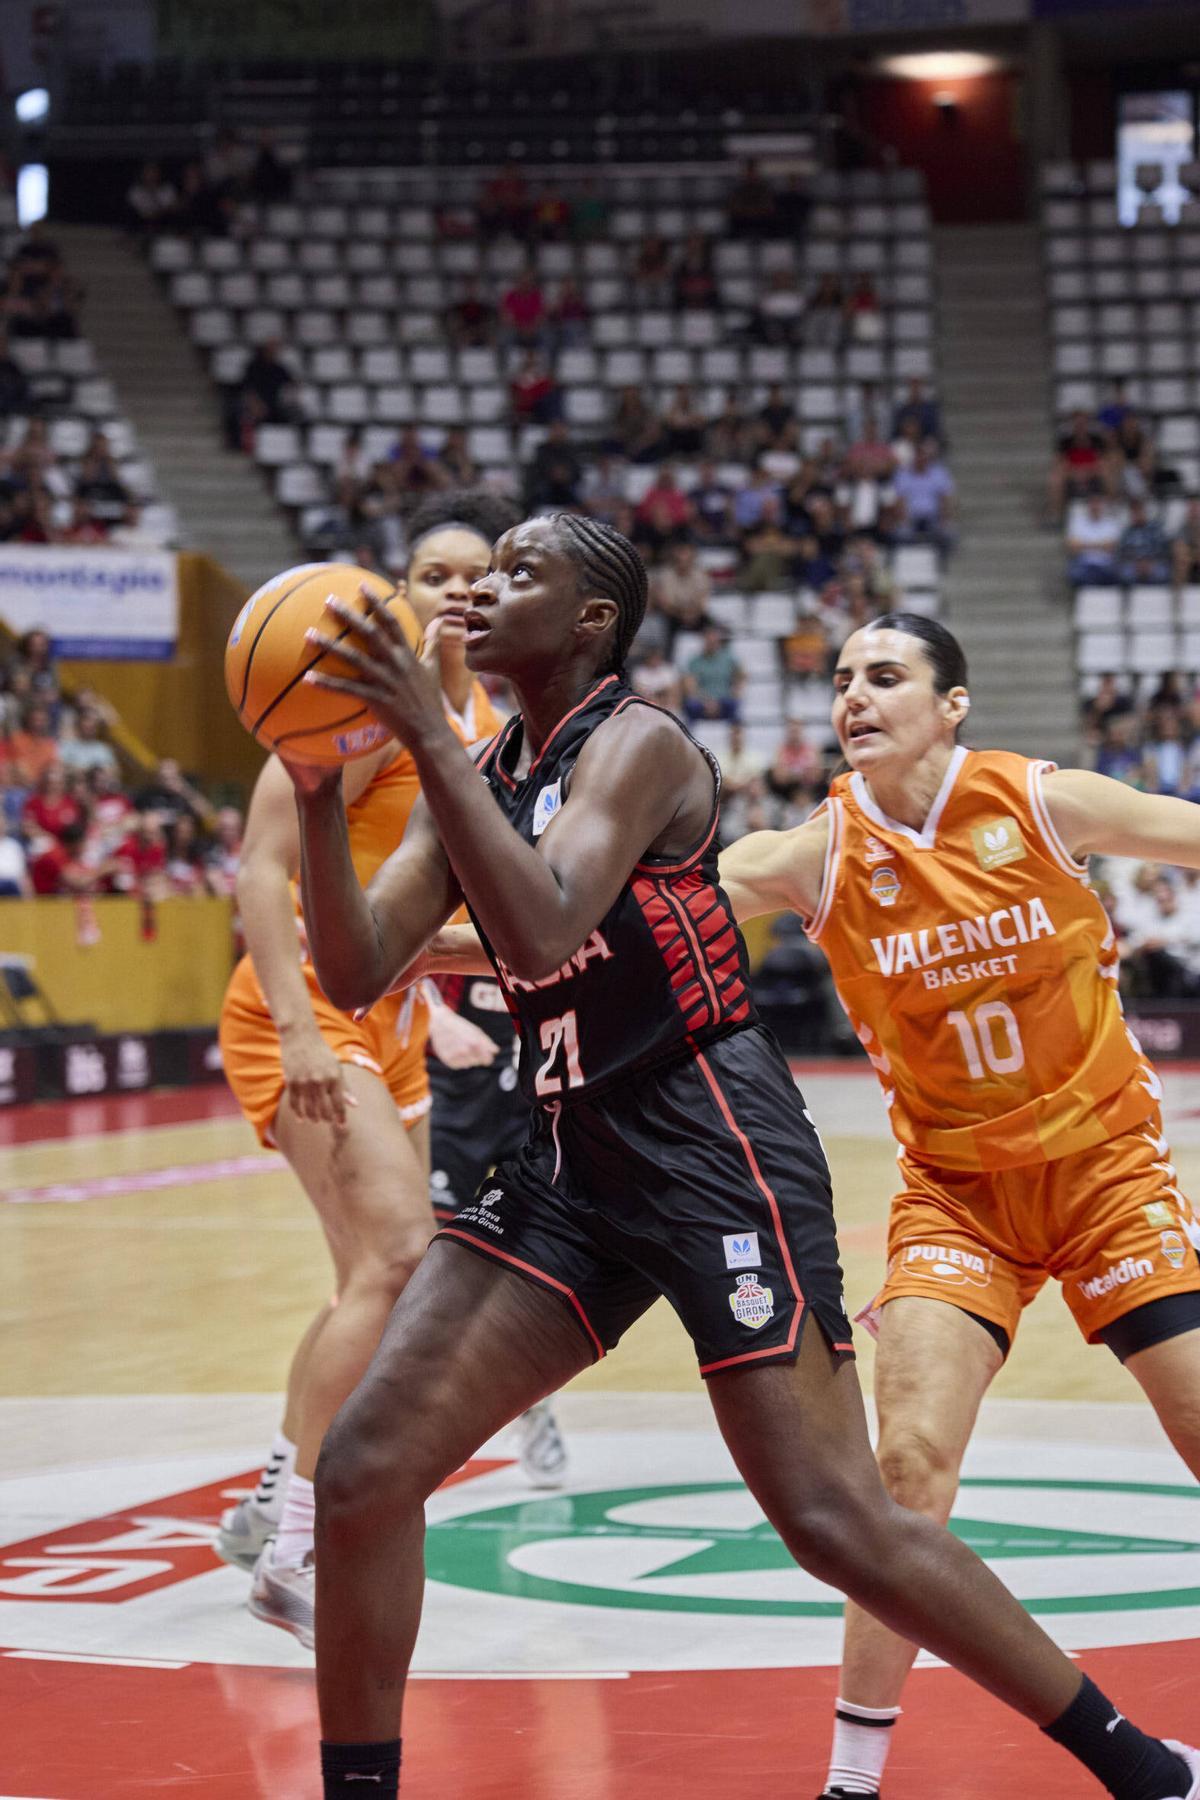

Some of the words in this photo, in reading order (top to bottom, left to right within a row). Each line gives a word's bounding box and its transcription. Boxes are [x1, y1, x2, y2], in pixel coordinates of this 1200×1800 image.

[870, 897, 1056, 978] VALENCIA
[922, 954, 1018, 990] BASKET
[946, 1001, 1025, 1079] 10
[478, 1207, 501, 1223] Brava
[478, 1217, 504, 1235] Girona
[907, 1245, 985, 1274] PULEVA
[737, 1274, 757, 1284] UNI
[736, 1304, 772, 1320] GIRONA
